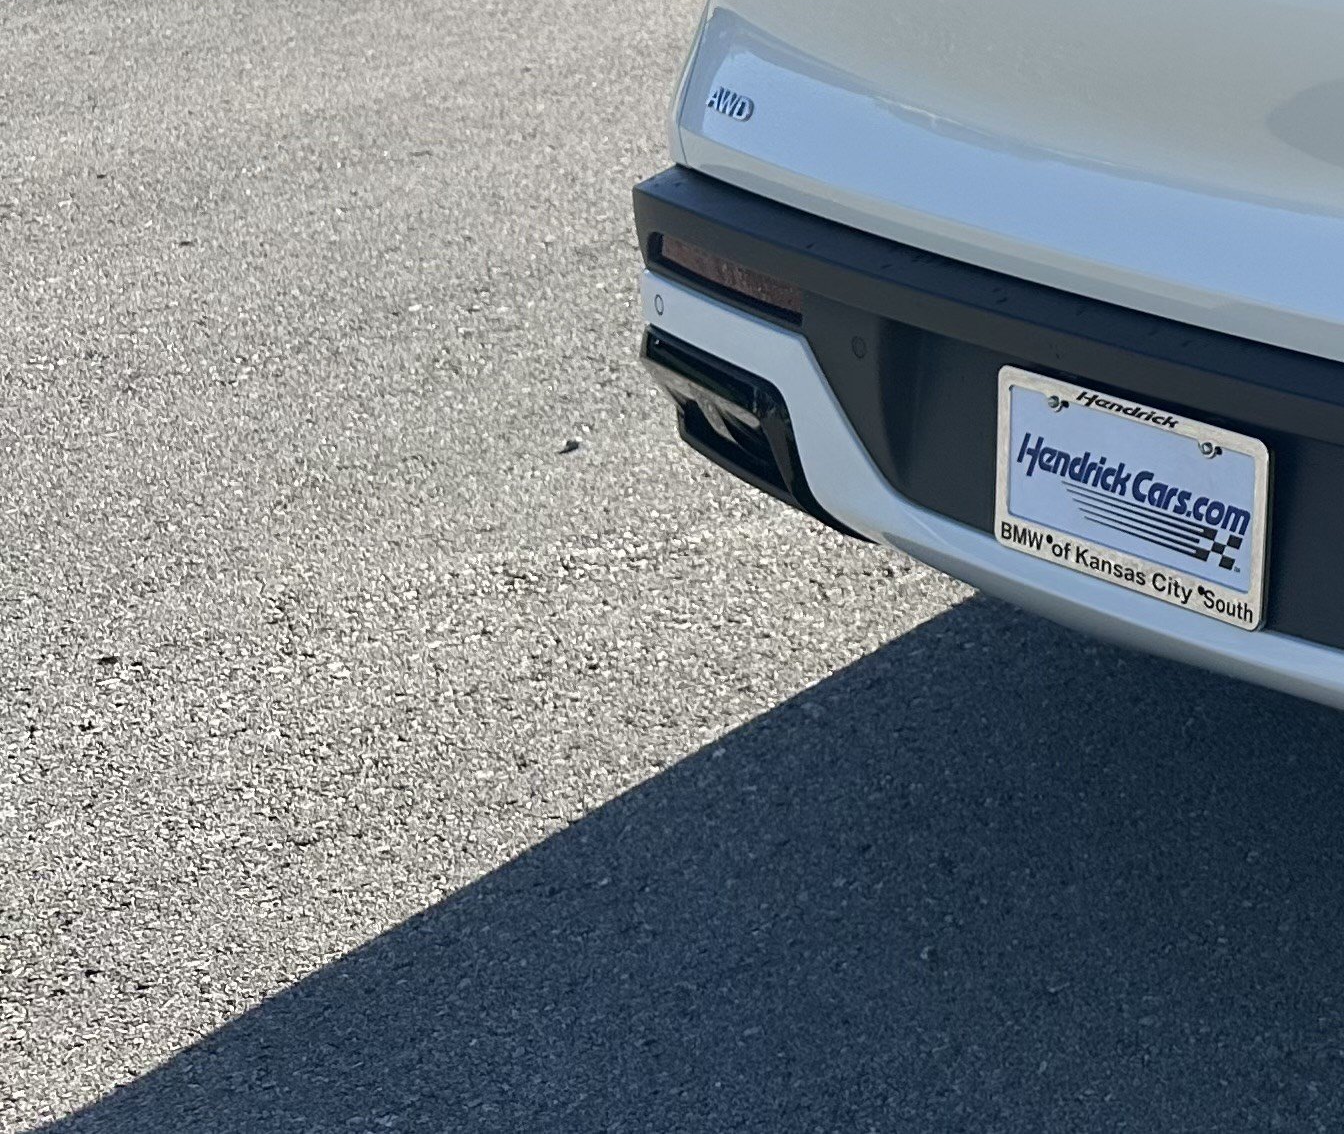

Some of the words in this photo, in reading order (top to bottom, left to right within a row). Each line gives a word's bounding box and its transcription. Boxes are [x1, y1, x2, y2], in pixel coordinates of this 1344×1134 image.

[706, 86, 754, 122] AWD
[1076, 391, 1179, 429] Hendrick
[1017, 432, 1250, 536] HendrickCars.com
[1001, 521, 1043, 551] BMW
[1052, 543, 1071, 560] of
[1075, 546, 1146, 586] Kansas
[1152, 572, 1193, 604] City
[1203, 589, 1253, 624] South
